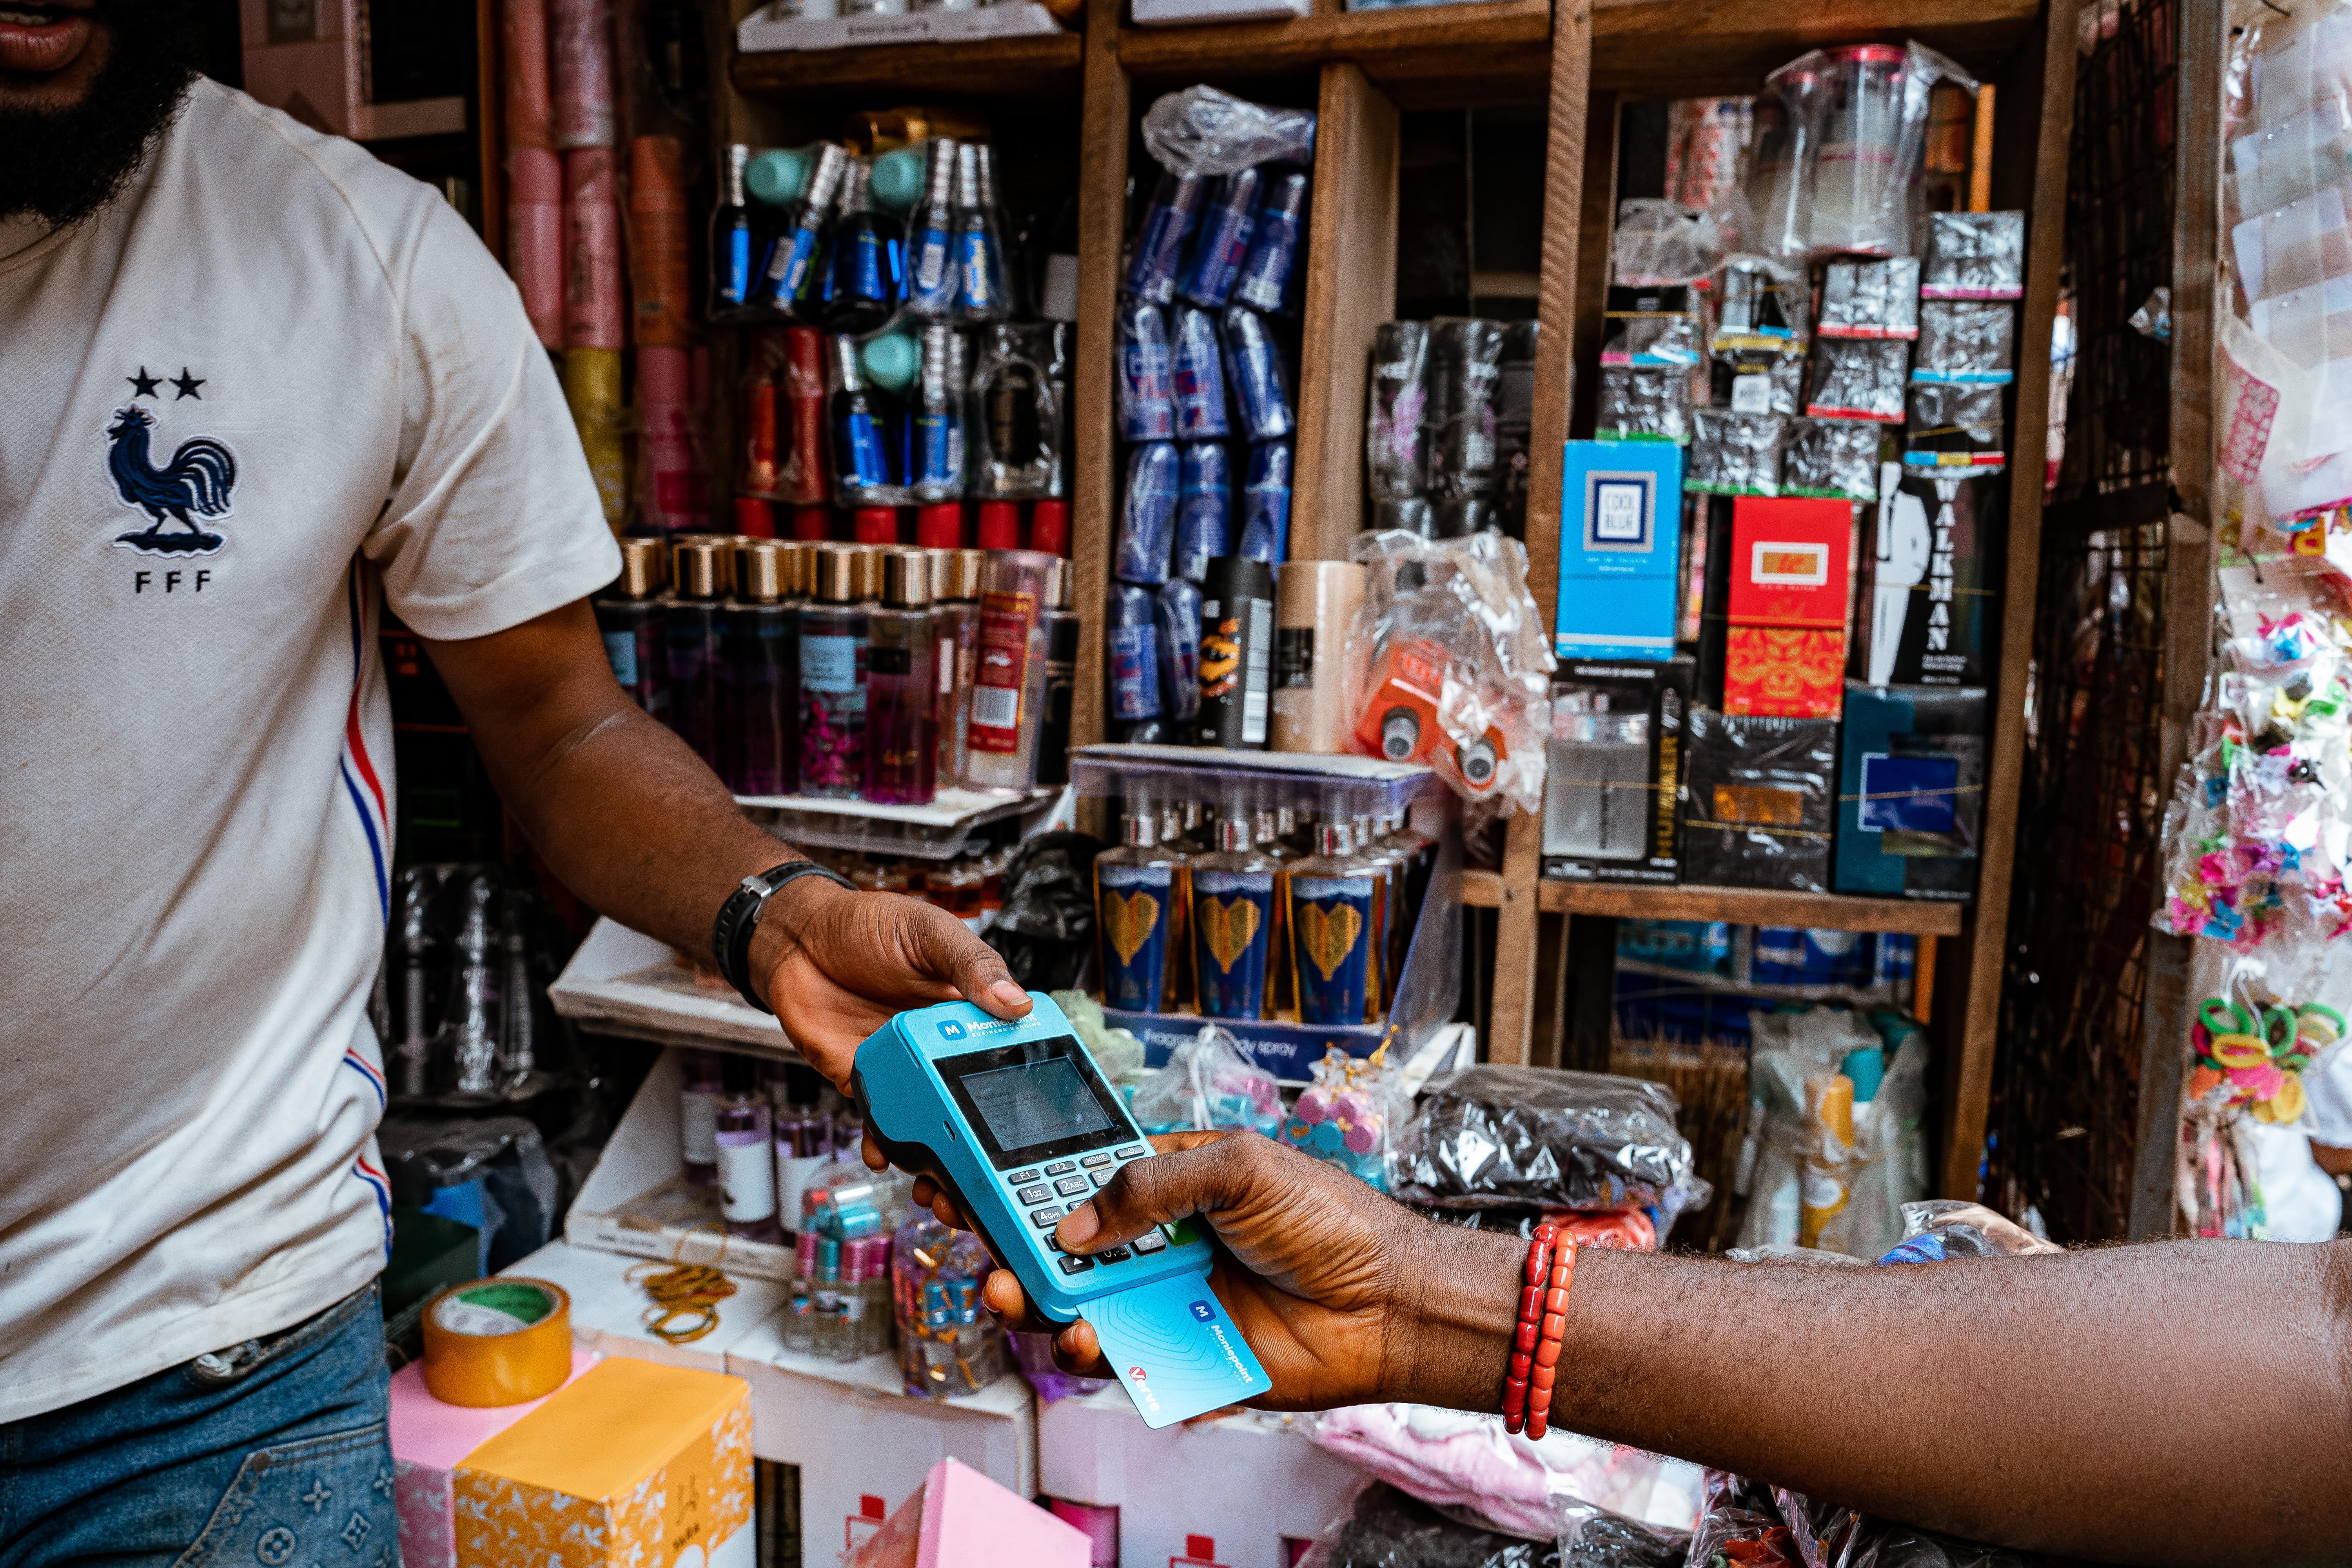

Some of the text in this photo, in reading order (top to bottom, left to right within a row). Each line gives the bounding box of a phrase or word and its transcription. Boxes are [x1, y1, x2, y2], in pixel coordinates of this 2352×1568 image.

[1604, 492, 1635, 511] COOL
[1604, 513, 1634, 531] BLUE
[1926, 479, 1959, 651] WALKMAN
[135, 570, 211, 594] FFF
[1656, 736, 1678, 858] HUMMER
[971, 1022, 1042, 1037] BUSINESS BANKING
[1257, 1040, 1297, 1059] spray
[1054, 1163, 1067, 1171] F2
[1085, 1154, 1107, 1163] HOME
[1019, 1171, 1031, 1180] F1
[1211, 1324, 1253, 1383] Moniepoint
[1131, 1367, 1160, 1412] Verve
